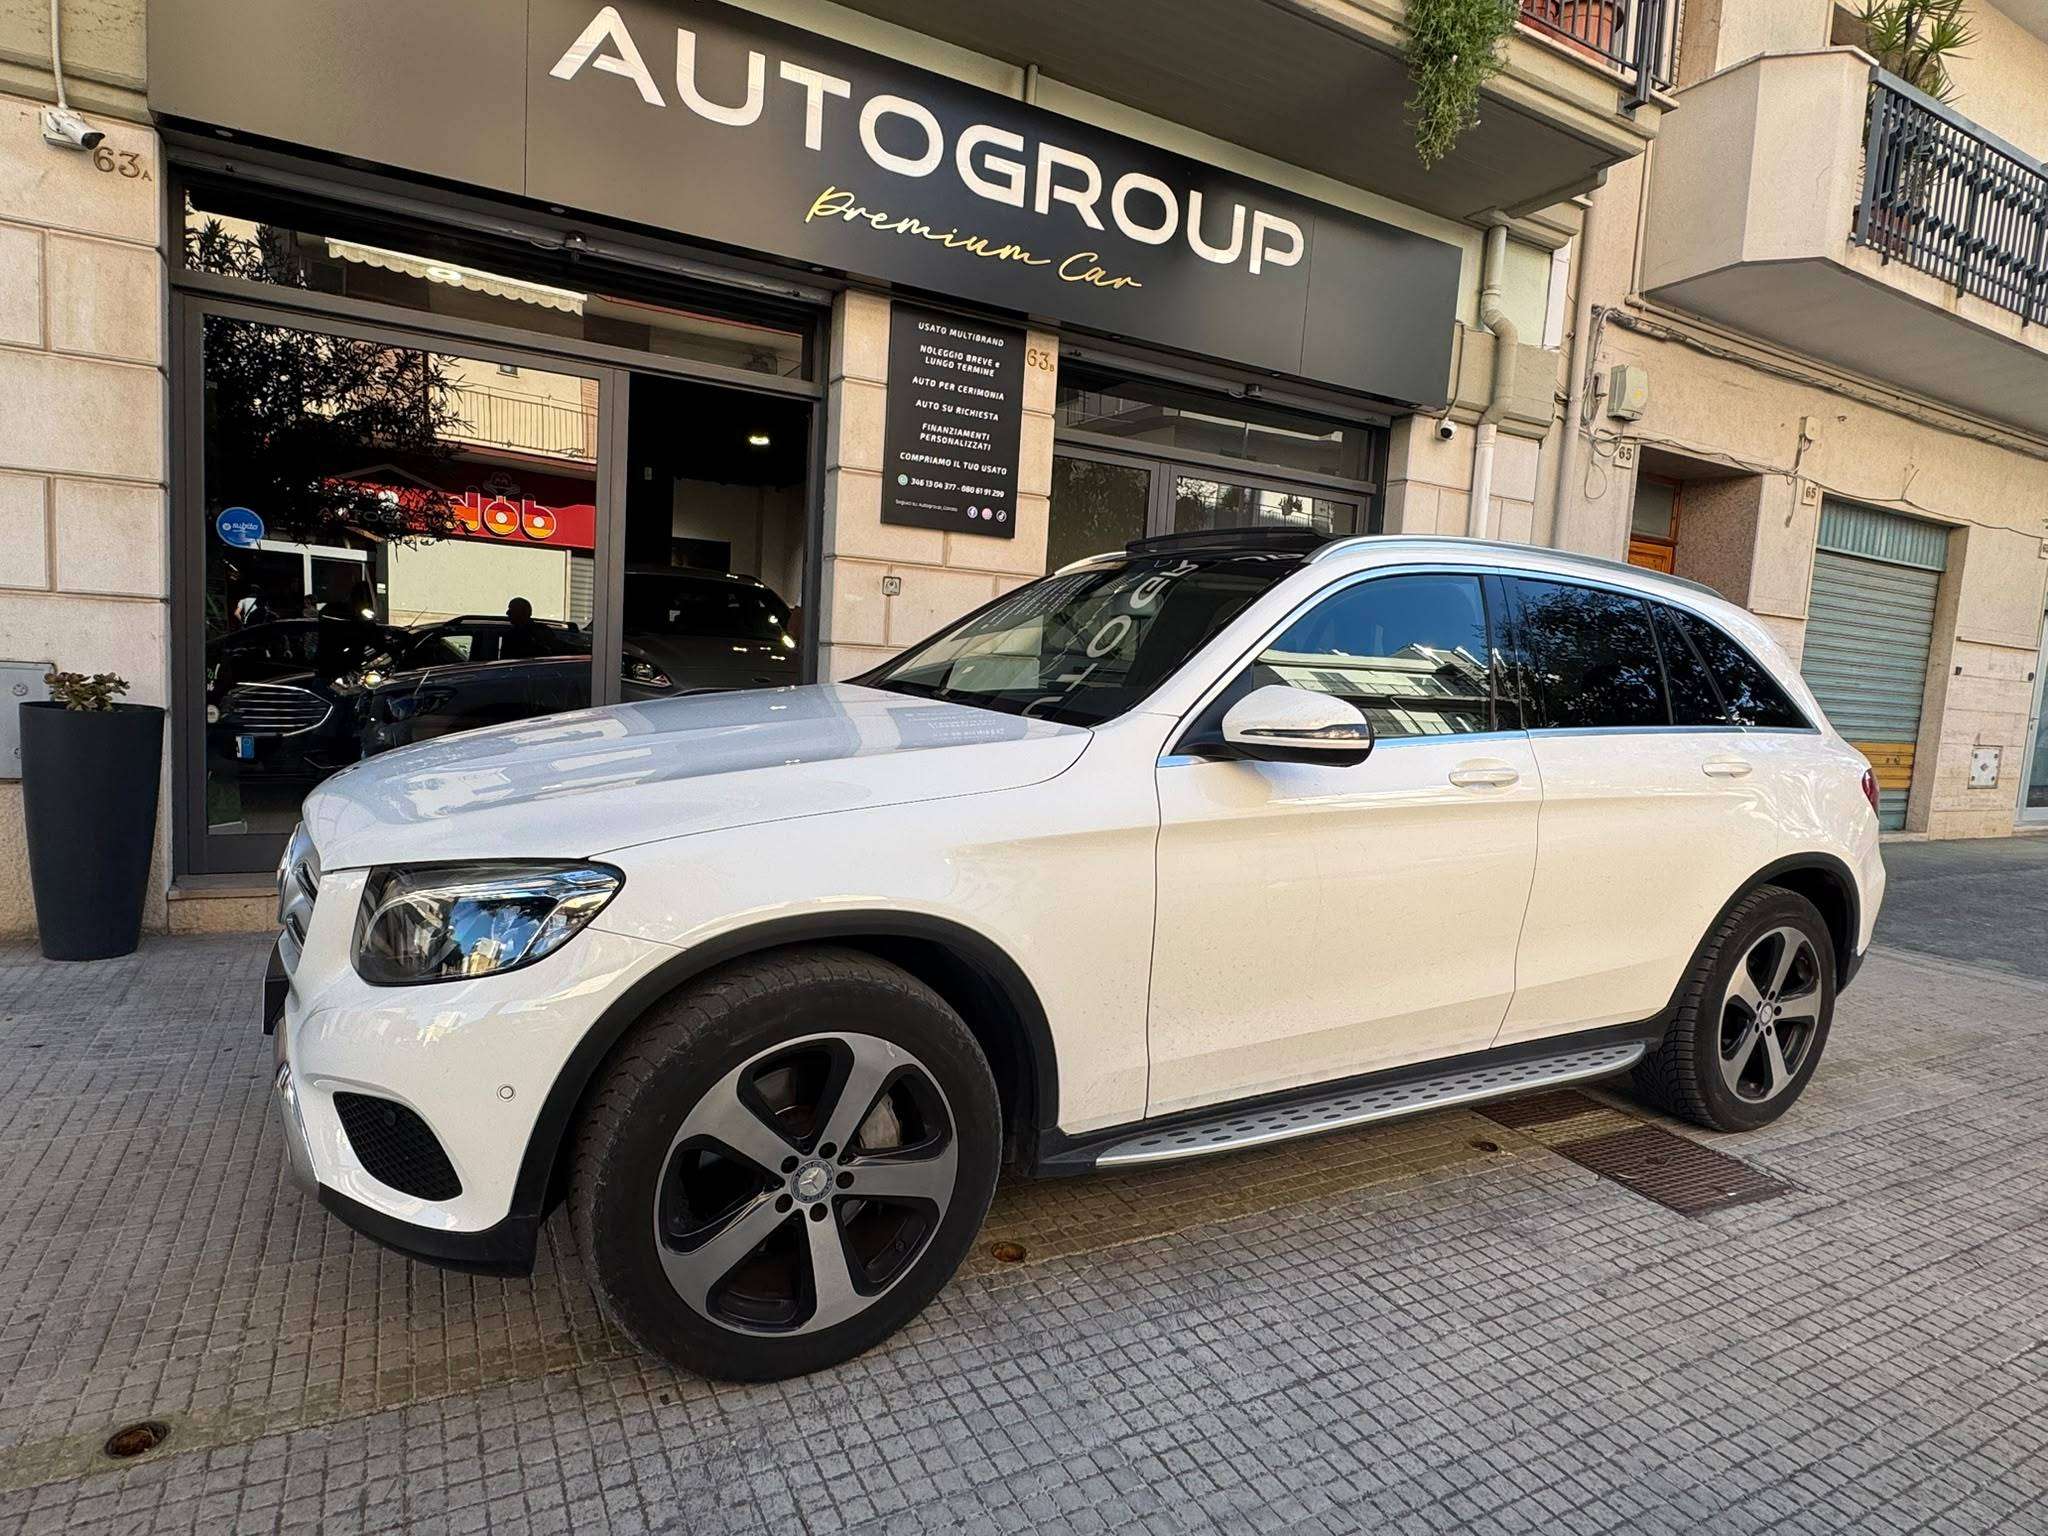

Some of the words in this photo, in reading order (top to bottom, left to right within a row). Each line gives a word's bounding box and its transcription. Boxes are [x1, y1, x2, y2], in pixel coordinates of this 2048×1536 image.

[549, 7, 1305, 276] AUTOGROUP
[804, 185, 1051, 266] Premium
[1058, 252, 1143, 290] Car
[918, 321, 947, 335] USATO
[949, 328, 1005, 347] MULTIBRAND
[920, 344, 964, 361] NOLEGGIO
[965, 354, 993, 367] BREVE
[994, 361, 1001, 369] e
[925, 356, 955, 369] LUNGO
[956, 362, 995, 377] TERMINE
[912, 375, 937, 387] AUTO
[938, 381, 956, 391] PER
[957, 385, 1005, 401] CERIMONIA
[915, 399, 940, 411] AUTO
[941, 404, 954, 413] SU
[955, 406, 999, 421] RICHIESTA
[919, 432, 992, 451] PERSONALIZZATI
[921, 422, 991, 441] FINANZIAMENTI
[899, 451, 952, 467] COMPRIAMO
[953, 460, 961, 469] IL
[963, 461, 980, 471] TUO
[981, 464, 1008, 476] USATO
[1618, 446, 1633, 461] 65
[1805, 486, 1817, 500] 65
